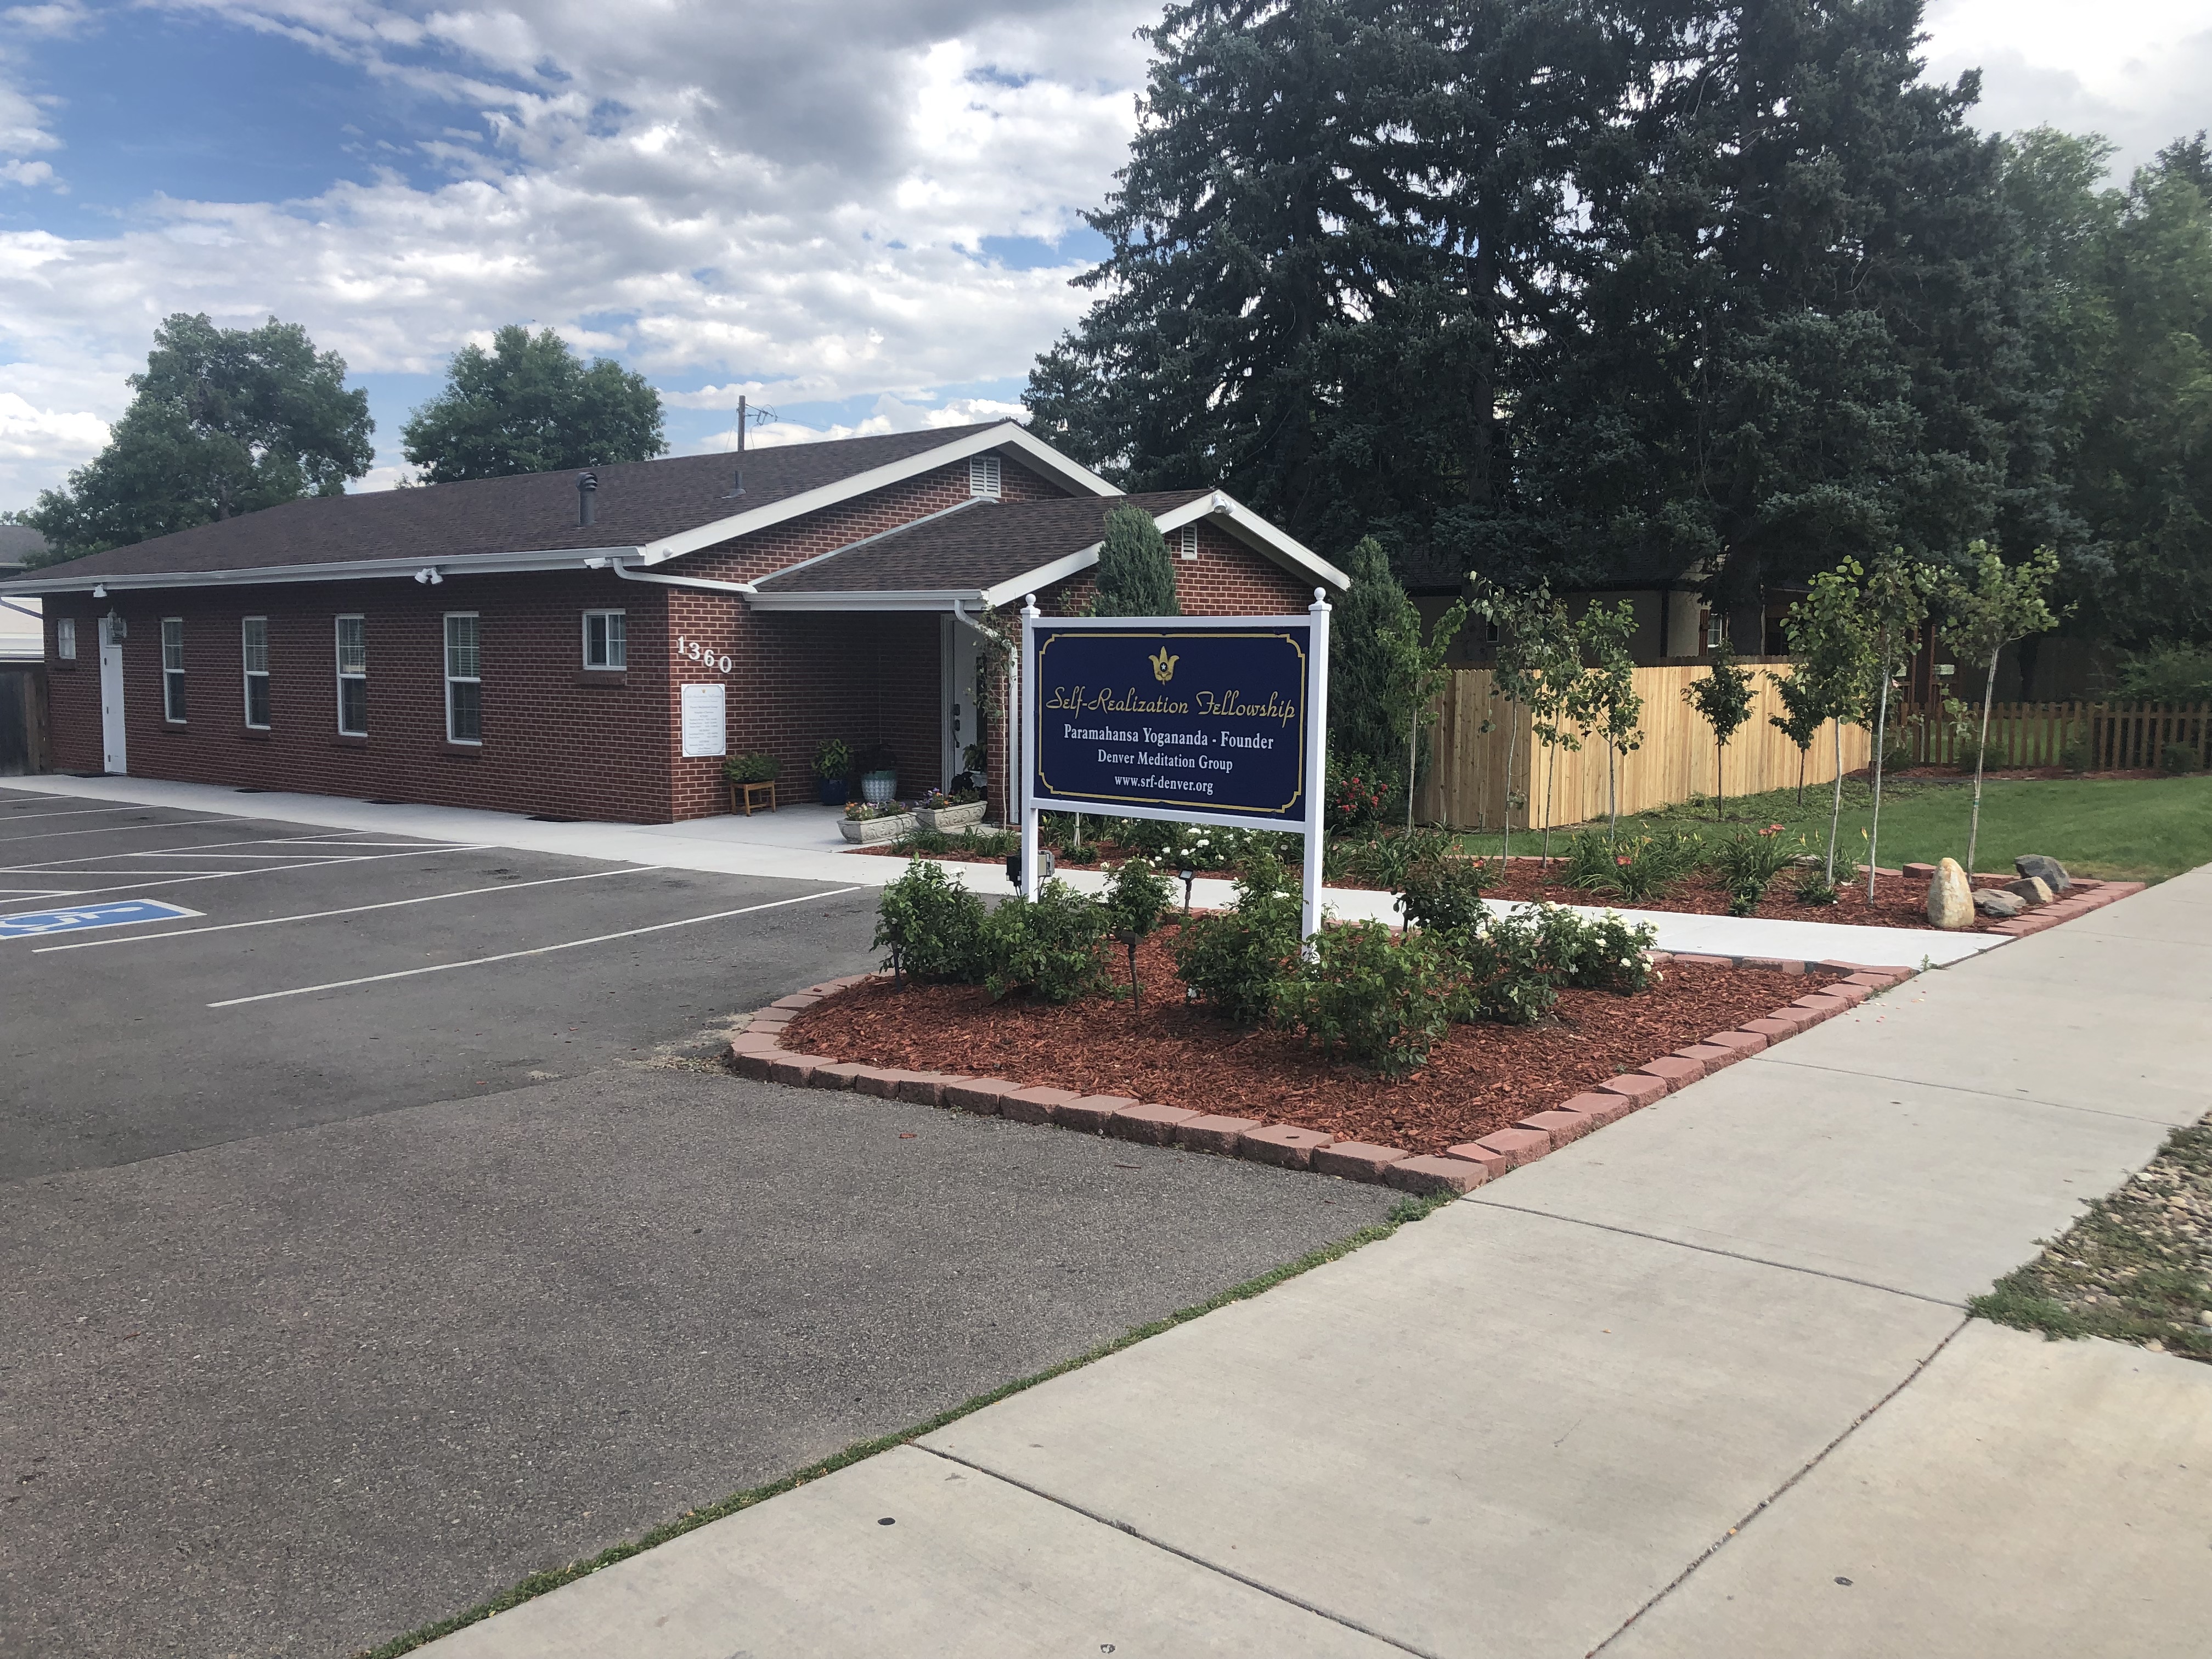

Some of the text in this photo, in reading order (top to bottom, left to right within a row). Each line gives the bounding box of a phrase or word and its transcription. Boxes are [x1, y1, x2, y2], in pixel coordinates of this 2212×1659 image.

[678, 635, 732, 673] 1360
[1046, 685, 1296, 729] Self-Realization Fellowship
[1063, 723, 1139, 742] Paramahansa
[1142, 727, 1208, 747] Yogananda
[1220, 731, 1274, 749] Founder
[1097, 749, 1233, 774] Denver Meditation Group
[1114, 774, 1214, 795] www.srf-denver.org
